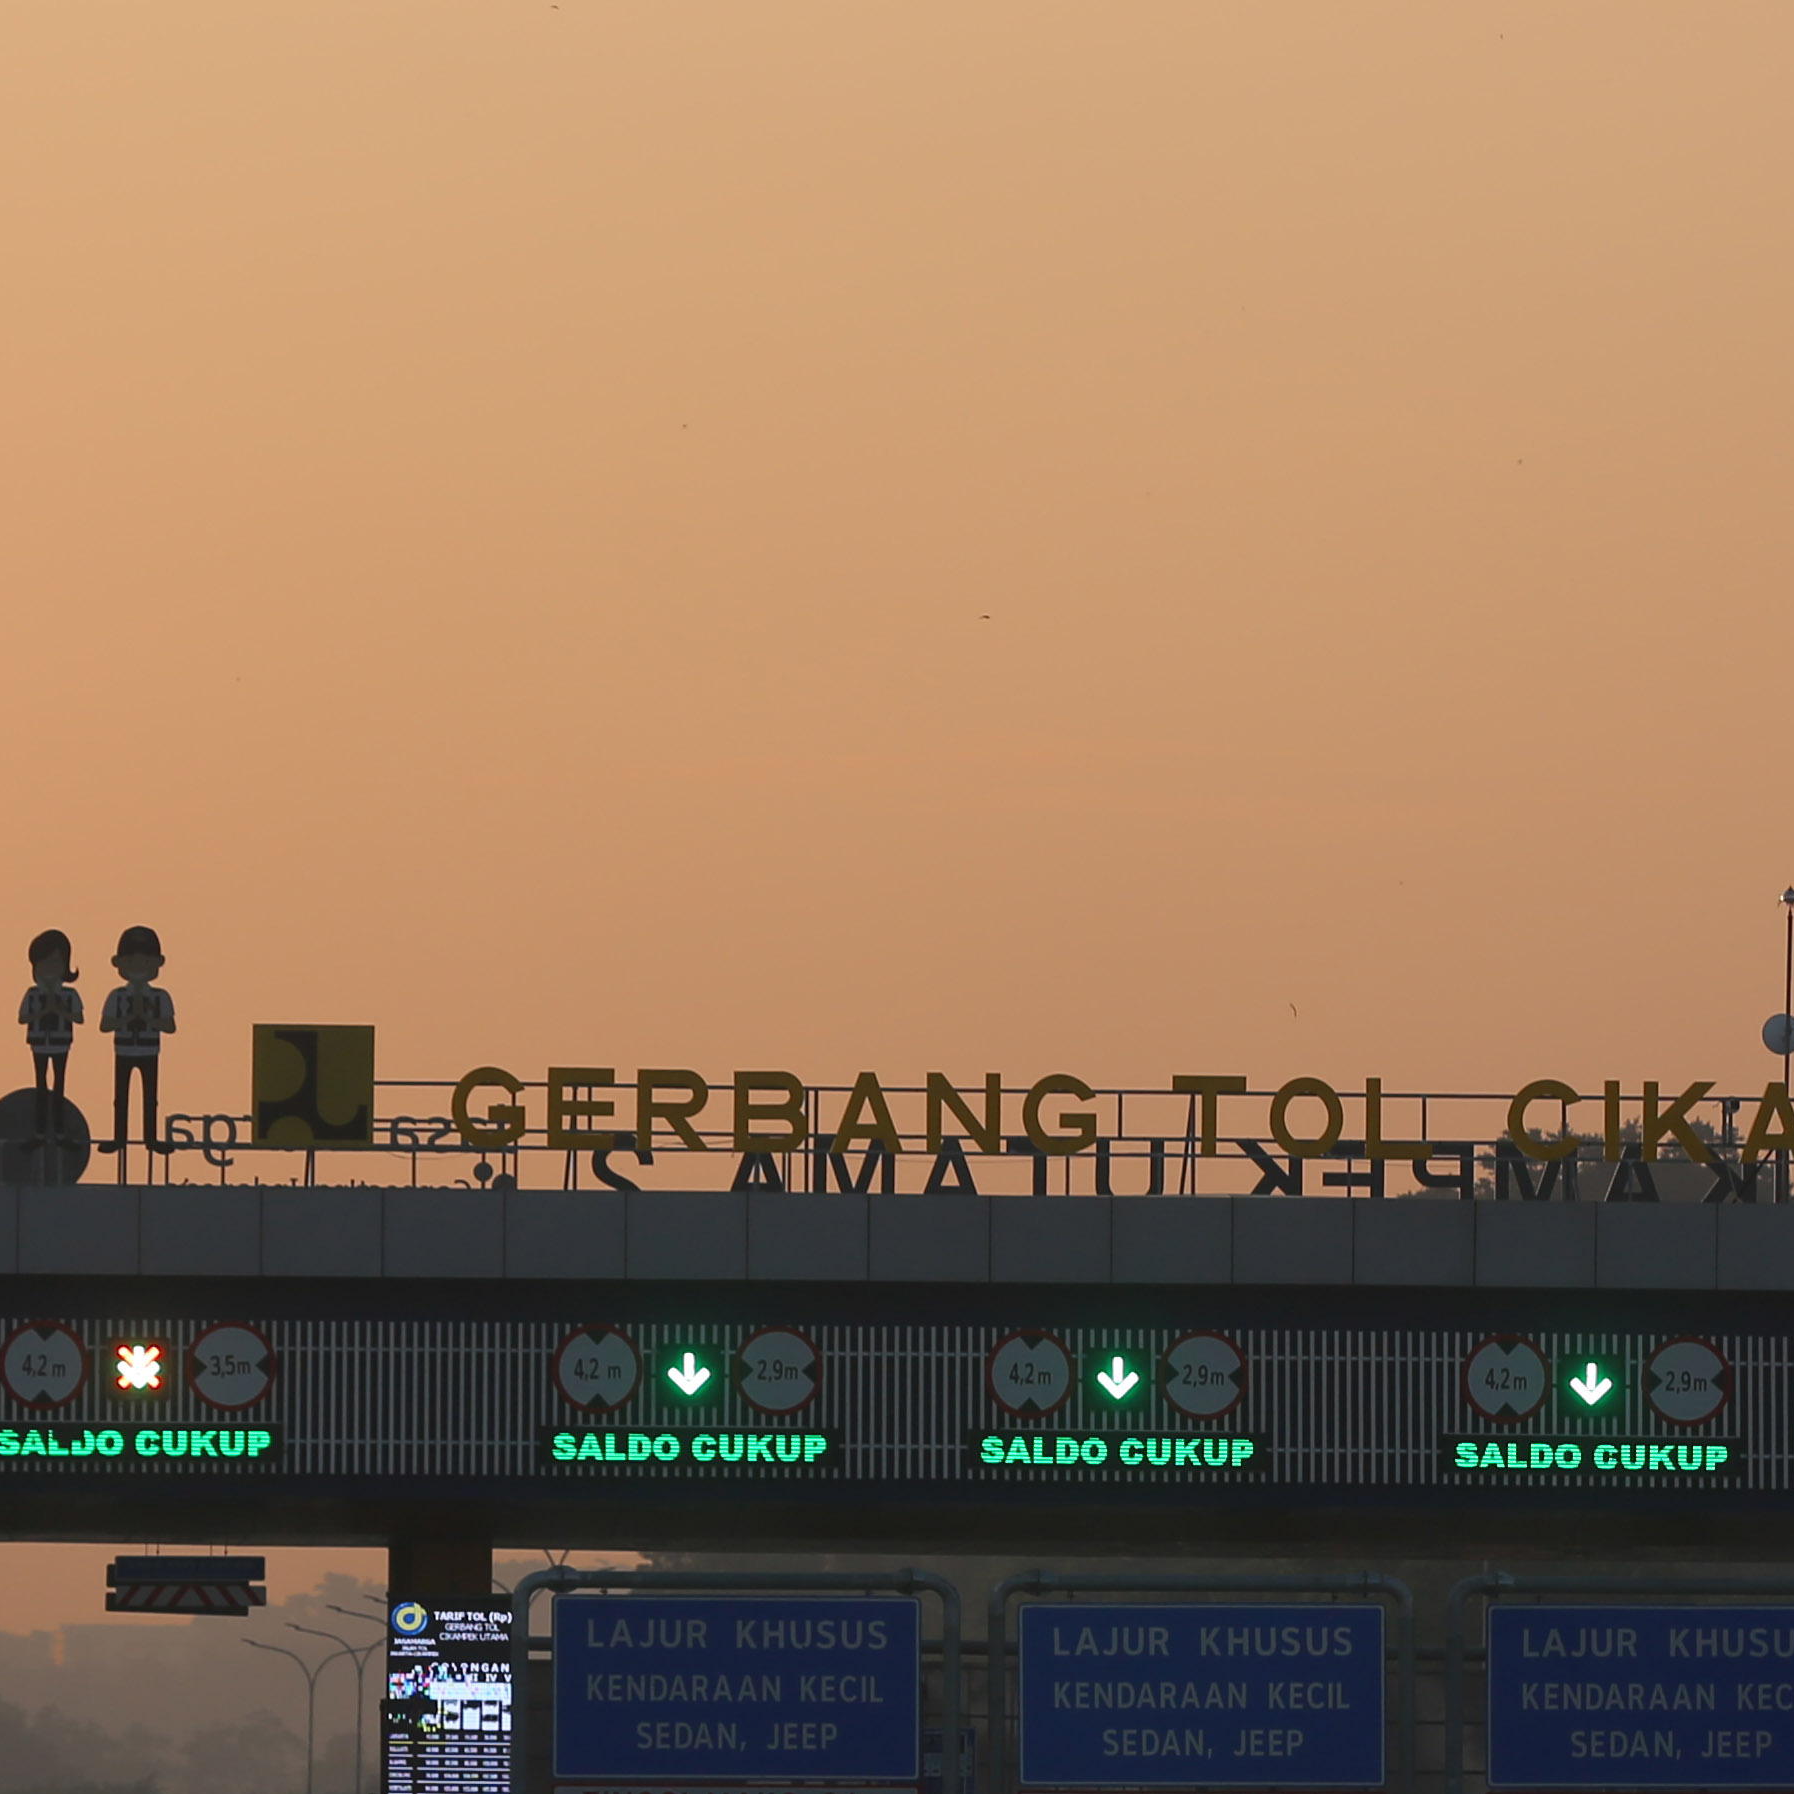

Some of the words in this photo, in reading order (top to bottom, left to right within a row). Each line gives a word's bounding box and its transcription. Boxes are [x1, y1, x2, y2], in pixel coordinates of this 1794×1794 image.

[450, 1066, 1097, 1155] GERBANG
[1172, 1075, 1432, 1161] TOL
[135, 1431, 271, 1457] CUKUP
[553, 1433, 680, 1460] SALDO
[692, 1434, 827, 1462] CUKUP
[981, 1436, 1107, 1464] SALDO
[1120, 1438, 1253, 1466] CUKUP
[1455, 1443, 1581, 1468] SALDO
[1594, 1445, 1727, 1470] CUKUP
[434, 1611, 466, 1622] TARIF
[467, 1612, 487, 1622] TOL
[588, 1619, 706, 1648] LAJUR
[737, 1620, 886, 1649] KHUSUS
[1054, 1627, 1168, 1656] LAJUR
[1201, 1627, 1352, 1656] KHUSUS
[1523, 1628, 1636, 1657] LAJUR
[588, 1675, 780, 1701] KENDARAAN
[801, 1676, 883, 1702] KECIL
[1055, 1682, 1246, 1708] KENDARAAN
[1269, 1682, 1350, 1709] KECIL
[1523, 1683, 1714, 1710] KENDARAAN
[637, 1722, 745, 1750] SEDAN,
[768, 1723, 837, 1749] JEEP
[1104, 1729, 1212, 1758] SEDAN,
[1234, 1730, 1303, 1756] JEEP
[1571, 1731, 1681, 1760] SEDAN,
[1702, 1731, 1772, 1757] JEEP
